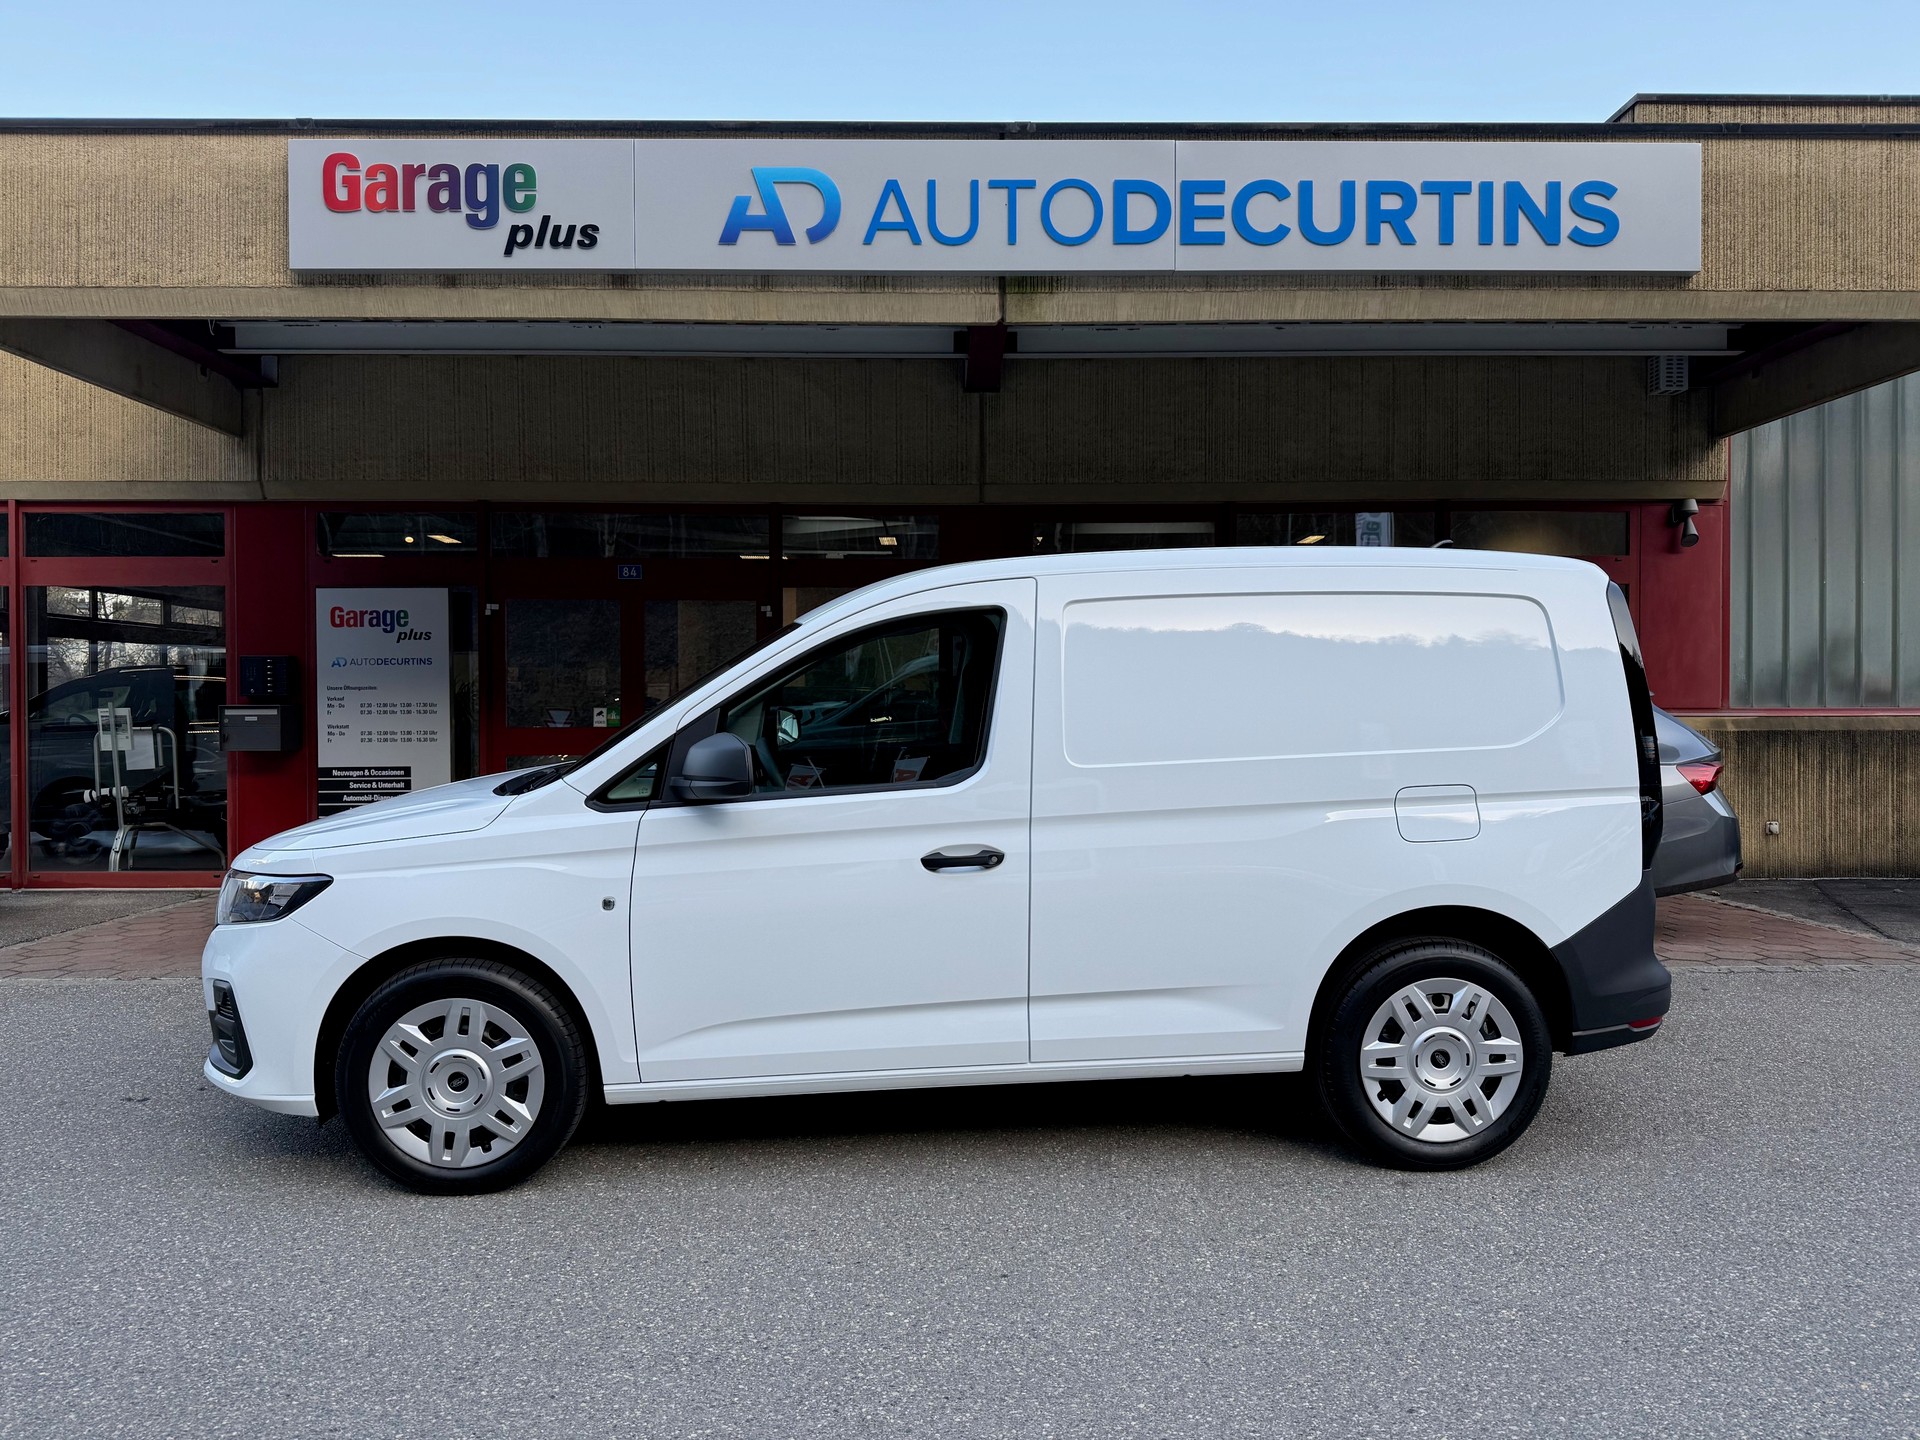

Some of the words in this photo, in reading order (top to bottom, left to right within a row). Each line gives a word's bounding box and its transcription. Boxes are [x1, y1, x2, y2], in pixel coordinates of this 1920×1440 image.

[321, 151, 538, 230] Garage
[863, 177, 1620, 247] AUTODECURTINS
[503, 214, 600, 257] plus
[622, 566, 637, 577] 84
[330, 606, 409, 633] Garage
[396, 628, 432, 643] plus
[350, 657, 432, 666] AUTODECURTINS
[332, 769, 364, 777] Neuwagen
